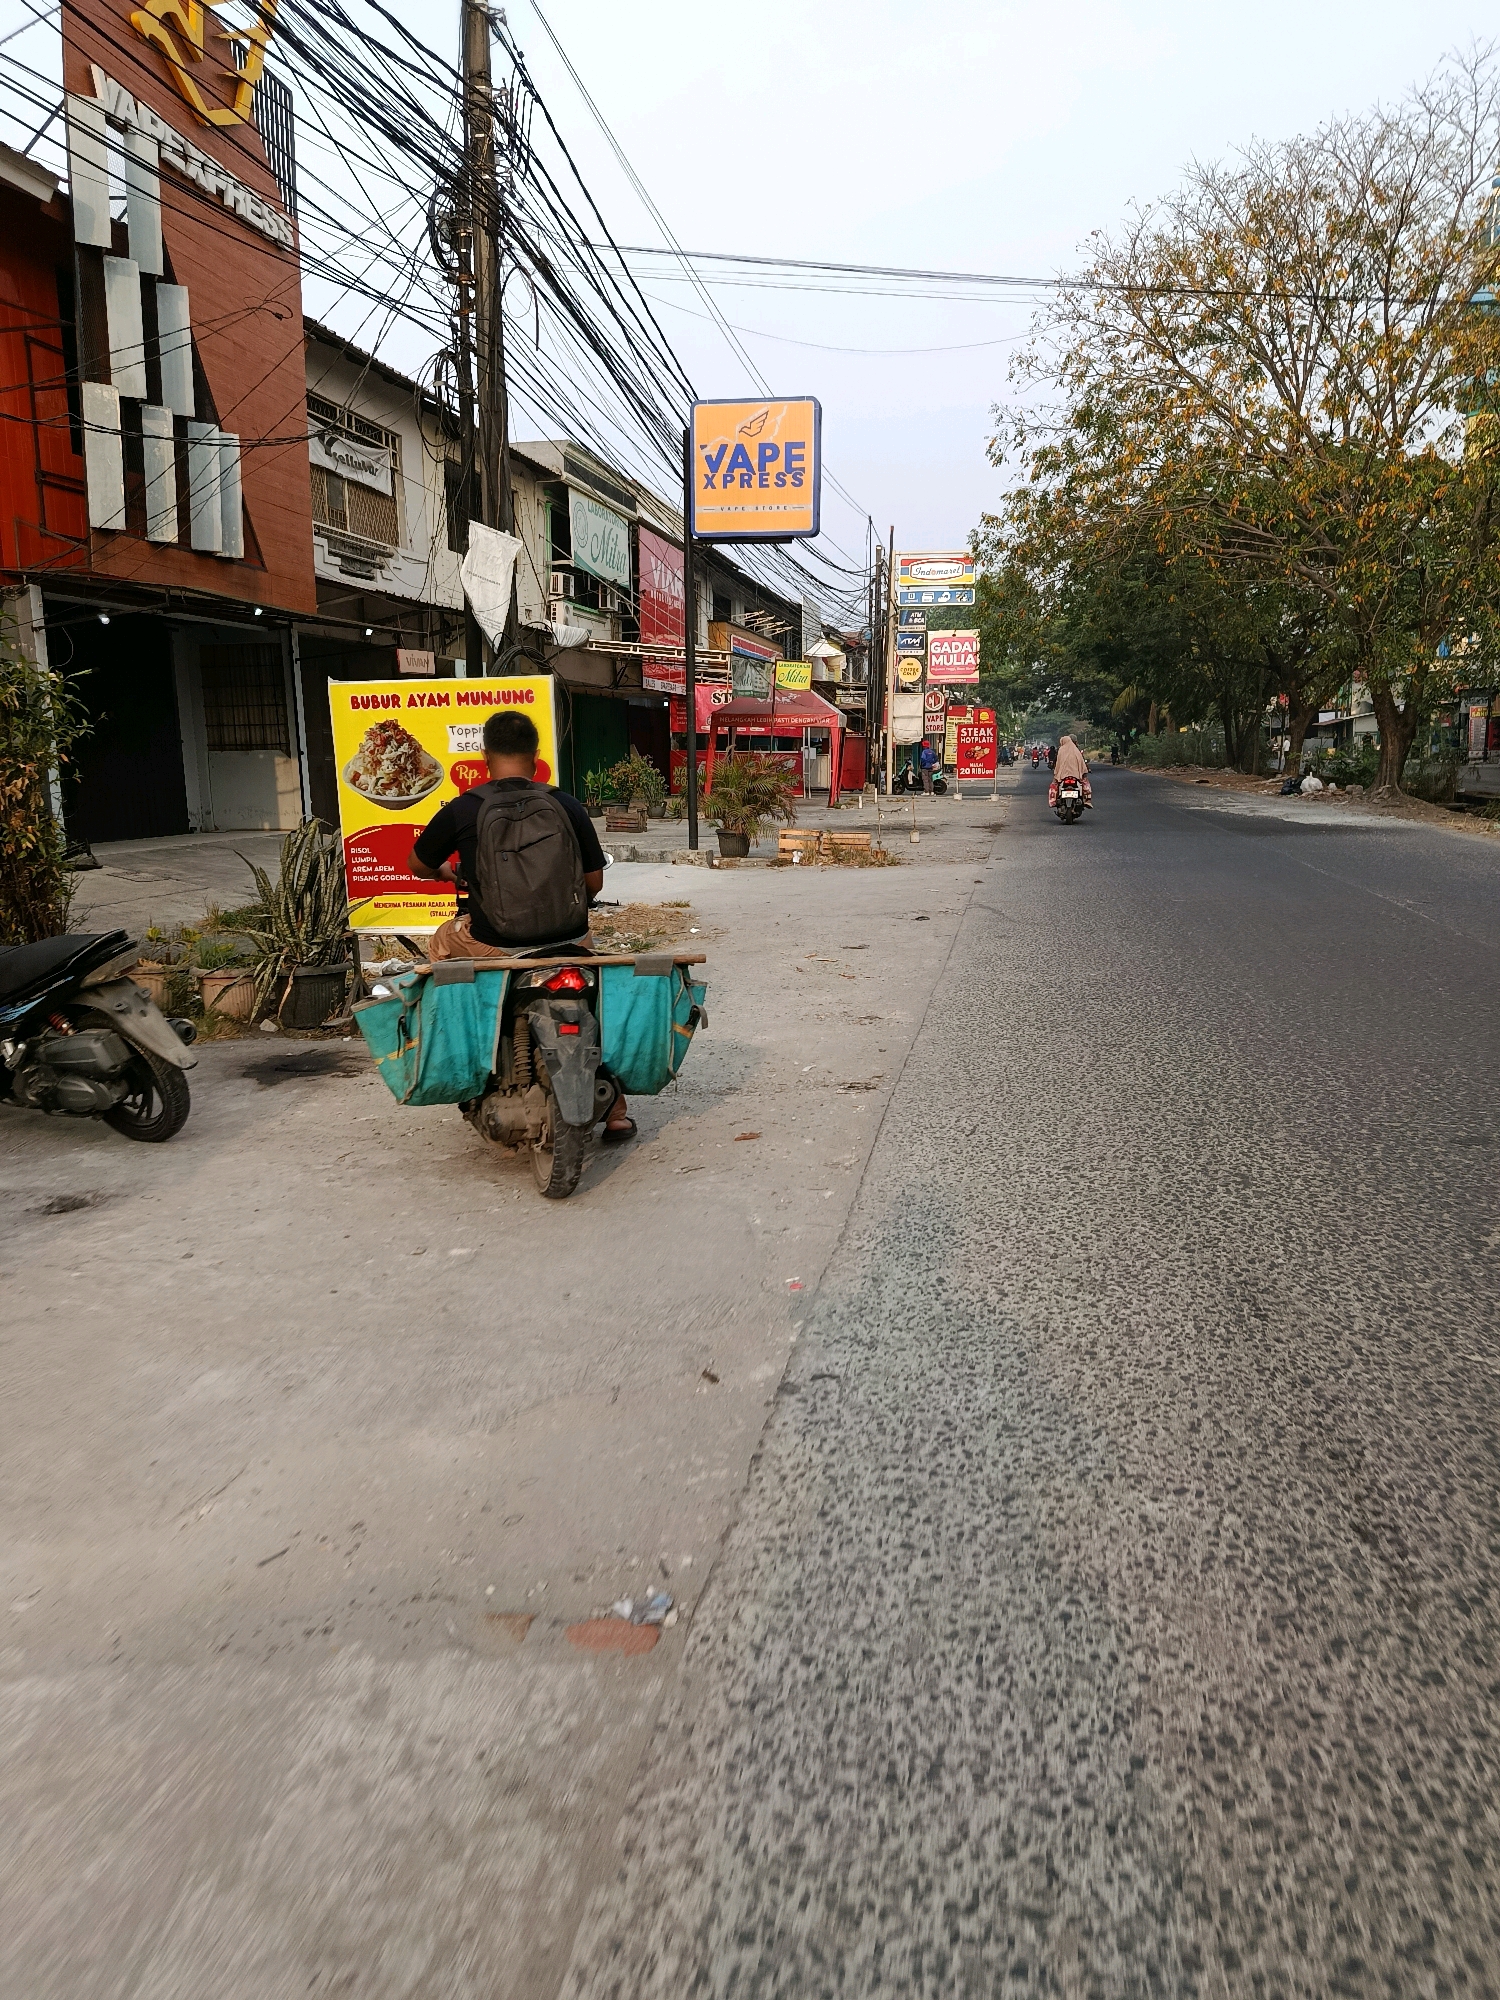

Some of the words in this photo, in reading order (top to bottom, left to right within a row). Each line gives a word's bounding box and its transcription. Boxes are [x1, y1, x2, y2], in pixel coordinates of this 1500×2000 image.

[700, 442, 805, 474] VAPE
[703, 472, 804, 489] XPRESS
[755, 504, 788, 512] STORE
[931, 641, 977, 653] GADAI
[931, 654, 976, 666] MULIA
[351, 694, 401, 710] BUBUR
[407, 692, 450, 708] AYAM
[457, 689, 535, 706] MUNJUNG
[926, 714, 943, 722] VAPE
[960, 727, 994, 737] STEAK
[960, 736, 994, 744] HOTPLATE
[352, 874, 379, 882] PISANG
